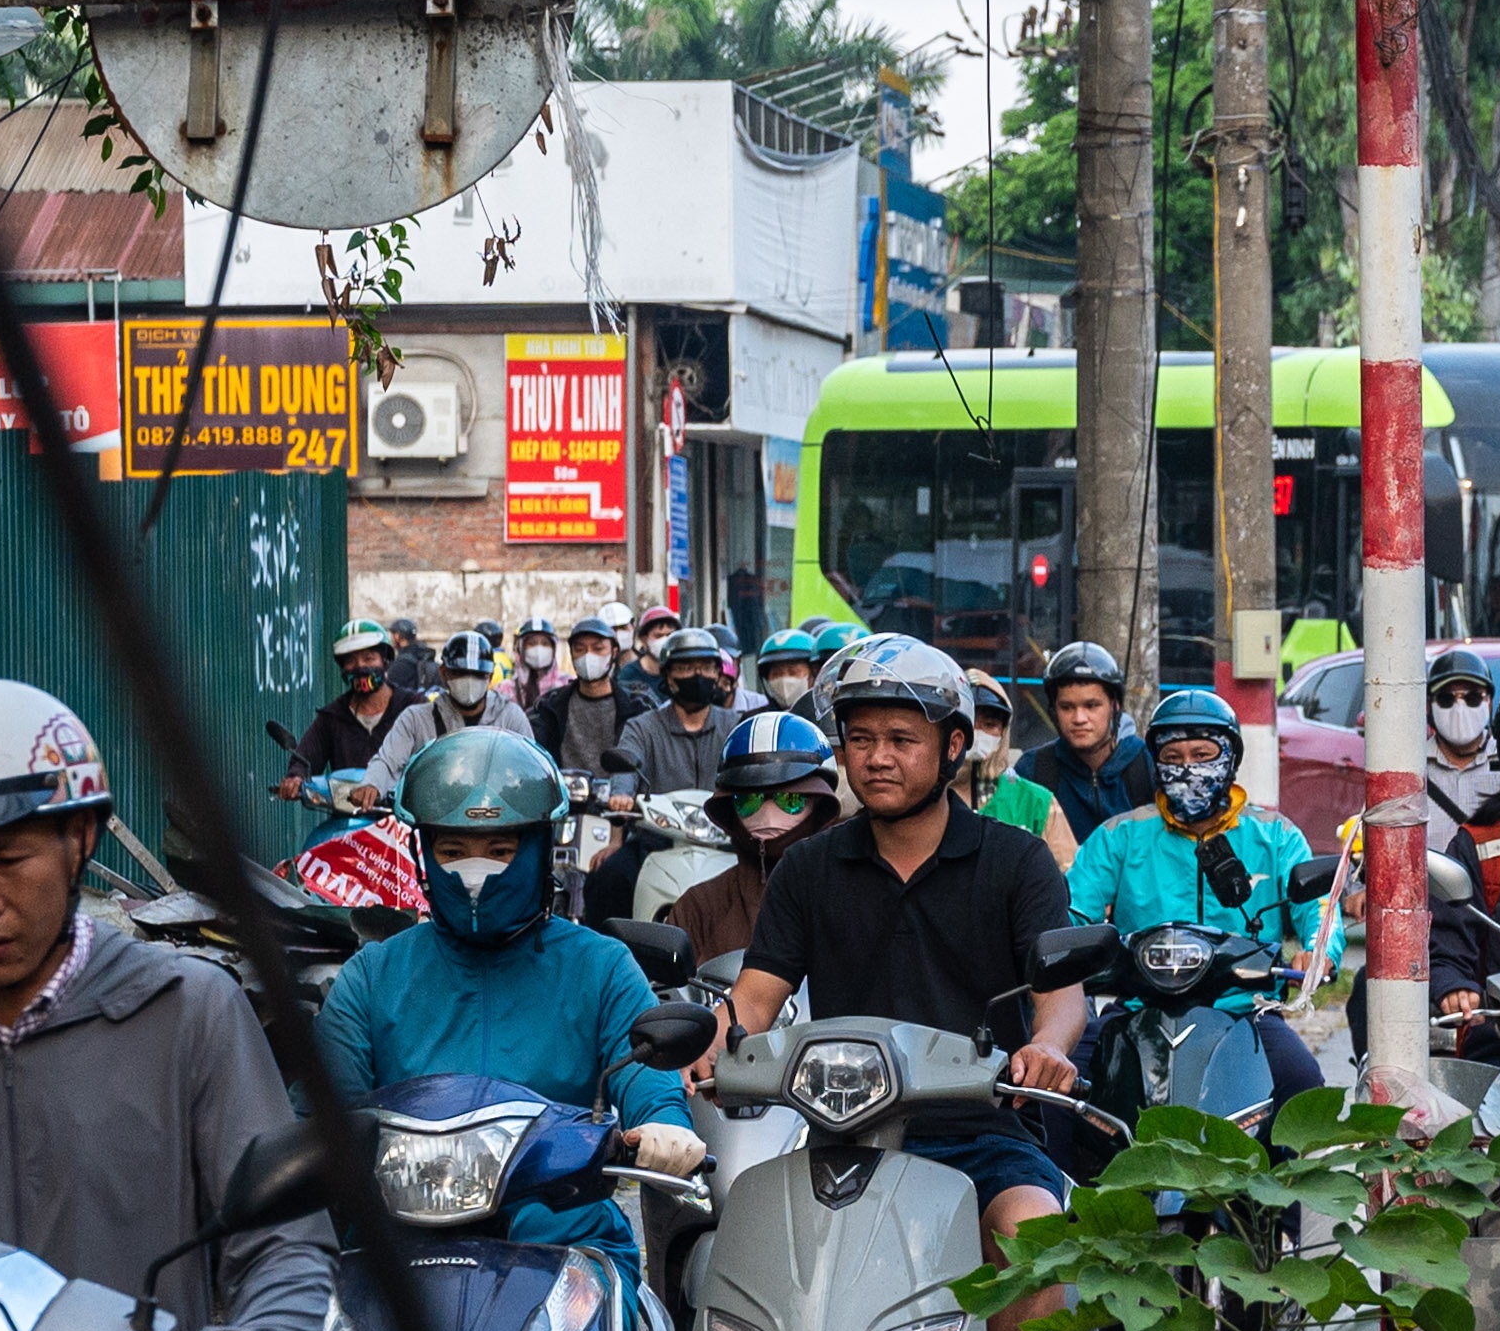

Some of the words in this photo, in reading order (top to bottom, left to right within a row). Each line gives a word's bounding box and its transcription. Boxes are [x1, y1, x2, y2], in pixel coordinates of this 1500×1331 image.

[134, 349, 190, 415] THẺ
[202, 355, 250, 415] TÍN
[260, 364, 346, 426] DỤNG
[510, 362, 567, 432] THÙY
[571, 374, 621, 432] LINH
[59, 405, 90, 432] TÔ
[287, 428, 347, 467] 247
[410, 1256, 479, 1267] HONDA
